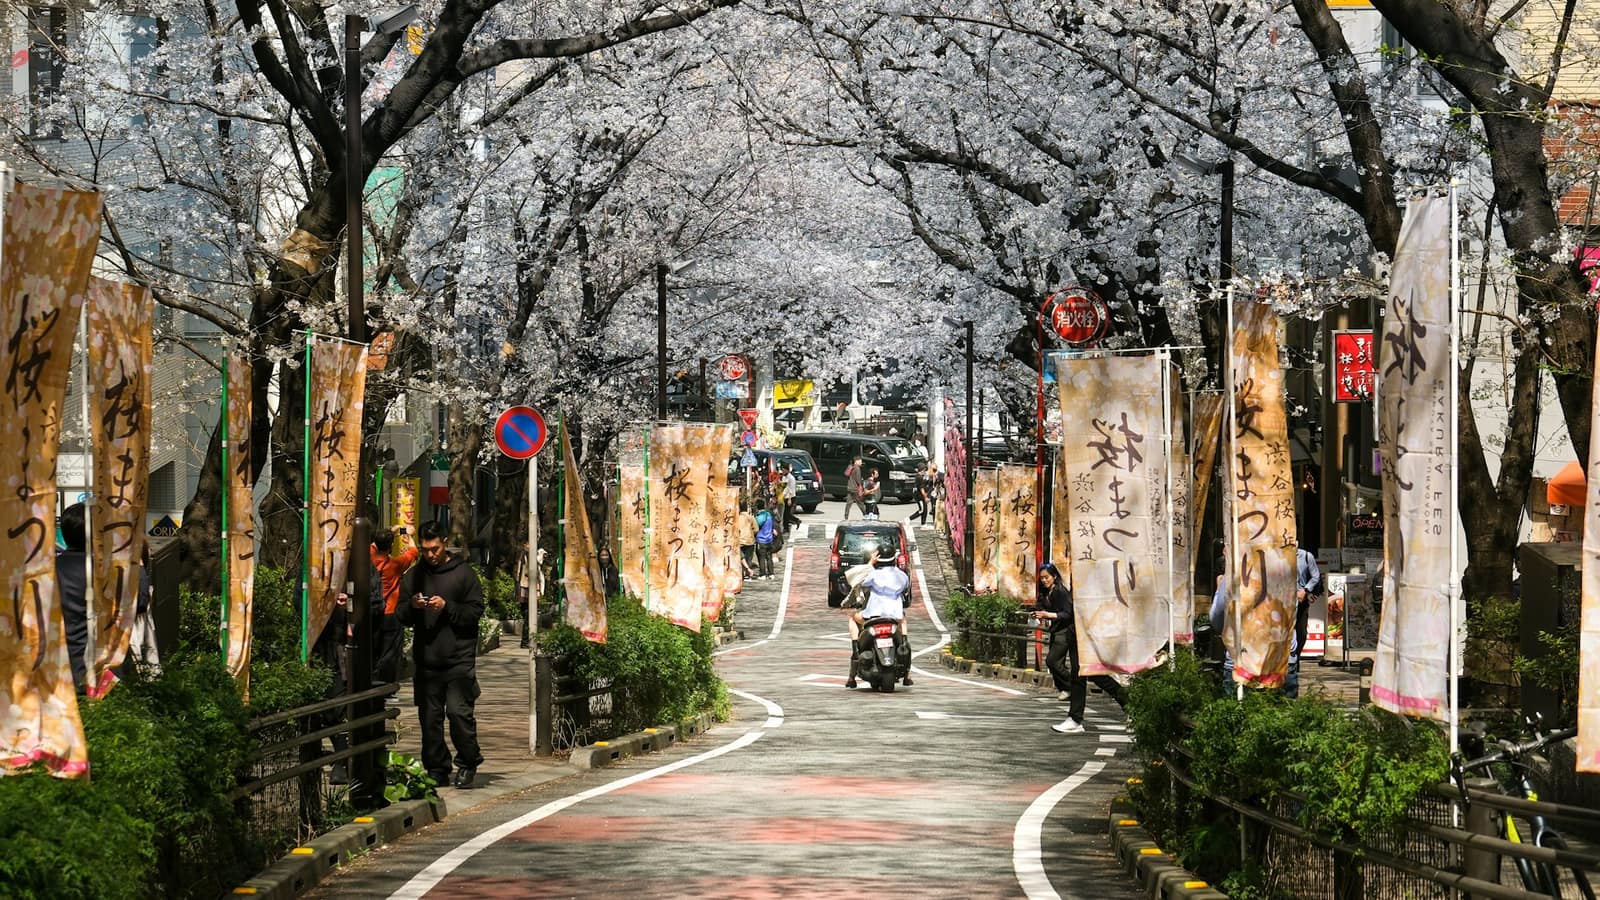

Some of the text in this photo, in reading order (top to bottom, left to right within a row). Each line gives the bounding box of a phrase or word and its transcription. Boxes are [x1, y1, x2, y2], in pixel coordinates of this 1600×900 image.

[1056, 310, 1095, 328] 消火栓
[6, 294, 60, 672] 桜まつり
[102, 359, 142, 632] 桜まつり
[153, 526, 179, 536] ORIX
[314, 401, 346, 598] 桜まつり
[662, 464, 694, 588] 桜まつり
[1011, 490, 1035, 575] 桜まつり
[1263, 441, 1296, 549] 渋谷桜丘
[1352, 518, 1384, 529] OPEN
